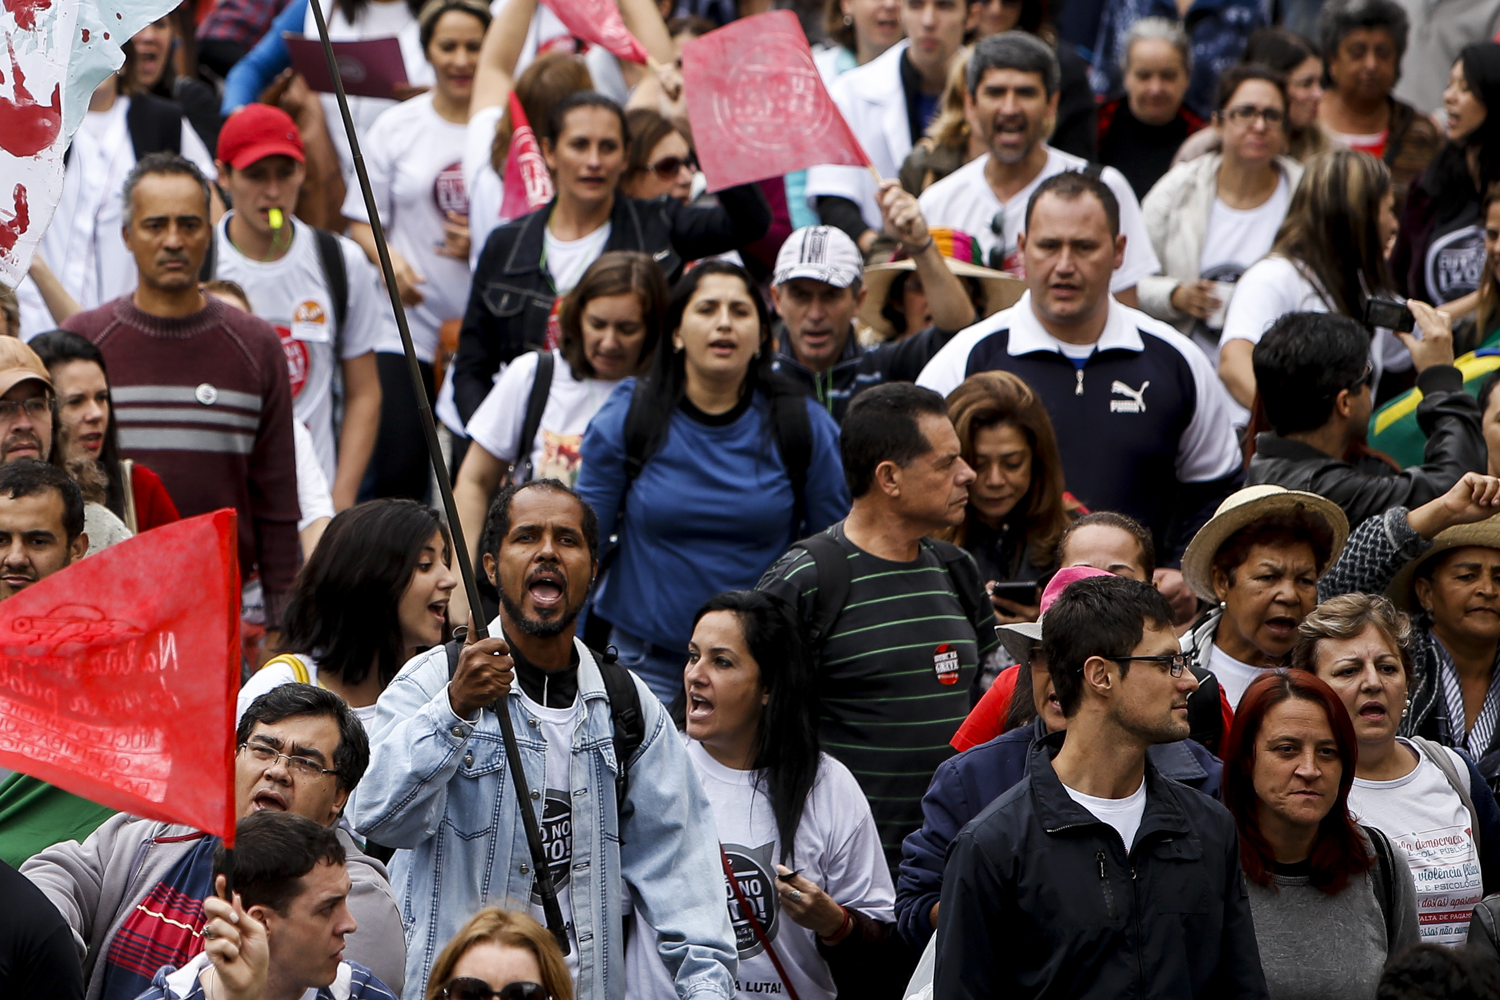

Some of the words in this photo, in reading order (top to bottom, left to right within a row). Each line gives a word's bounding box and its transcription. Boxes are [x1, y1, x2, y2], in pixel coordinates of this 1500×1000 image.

[552, 820, 571, 839] NO
[1418, 867, 1463, 882] violência
[1439, 925, 1453, 936] não
[745, 982, 782, 994] LUTA!
